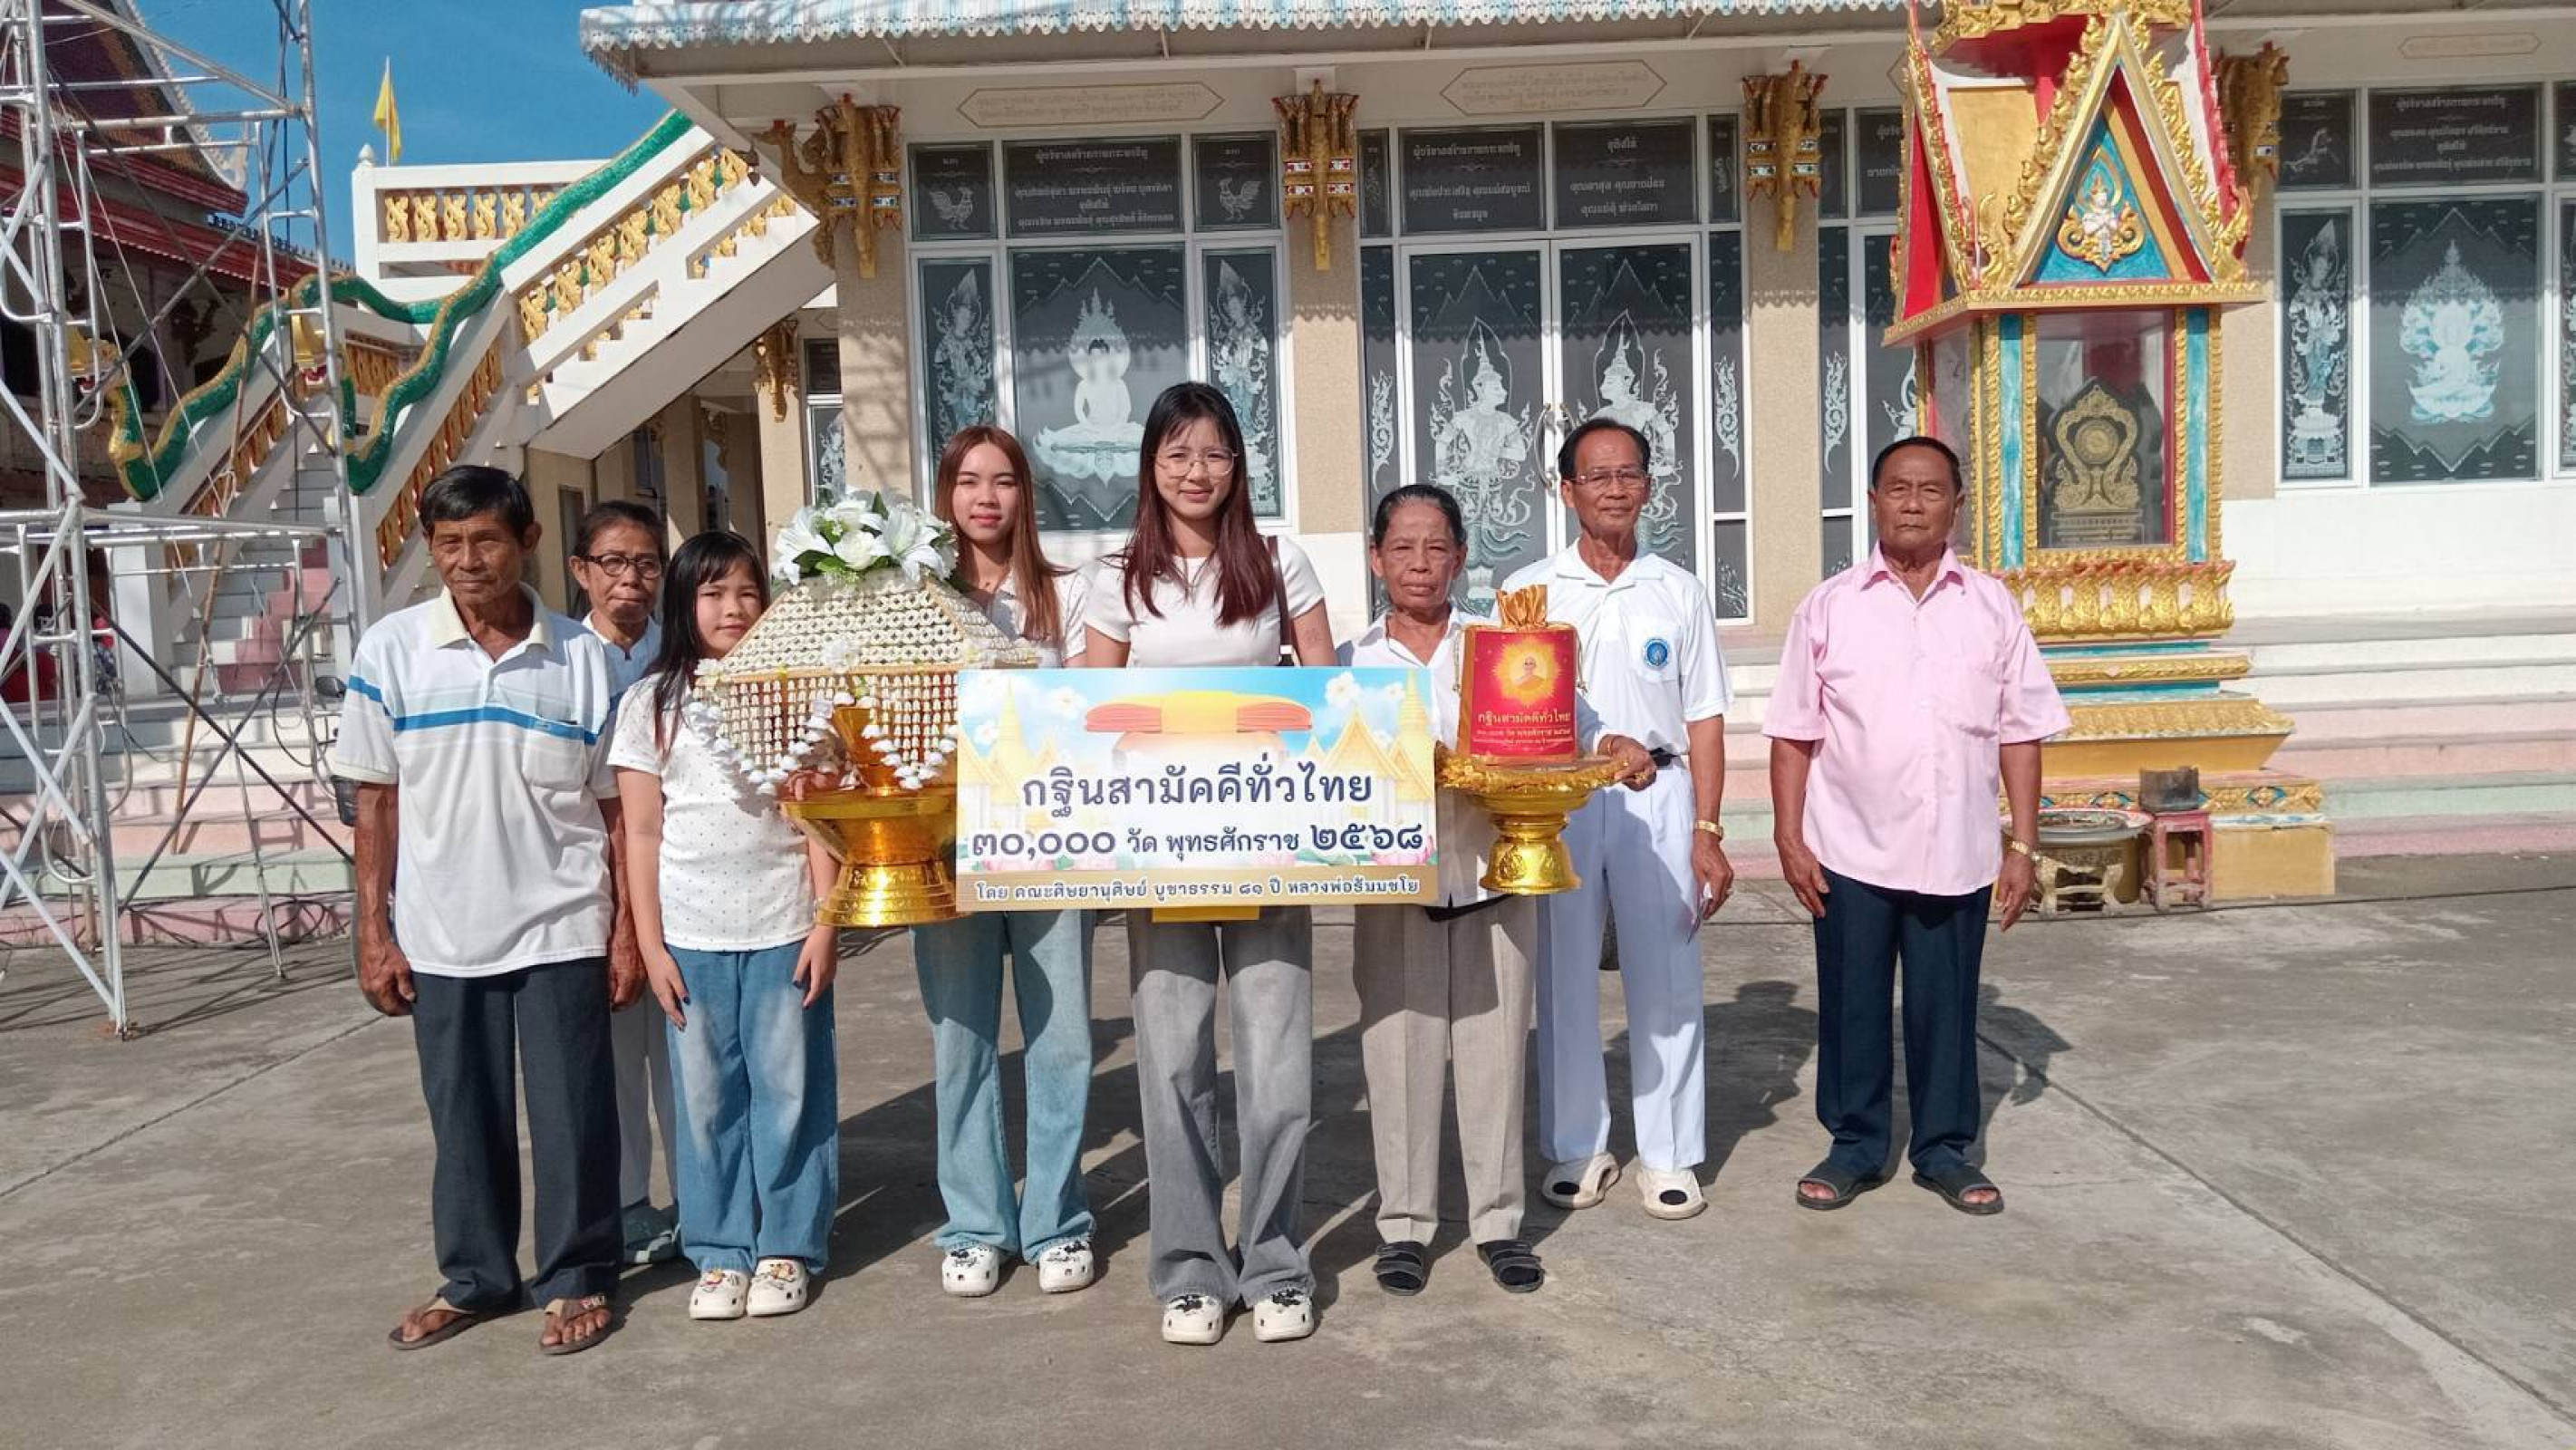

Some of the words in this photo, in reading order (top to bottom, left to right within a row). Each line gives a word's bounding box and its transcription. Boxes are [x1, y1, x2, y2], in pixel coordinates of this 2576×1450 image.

[1023, 753, 1373, 817] กฐินสามัคคีทั่วไทย
[972, 826, 1116, 860] ๓๐,๐๐๐
[1127, 826, 1158, 855] วัด
[1168, 826, 1299, 862] พุทธศักราช
[1310, 821, 1423, 852] ๒๕๖๘
[977, 881, 1008, 900] โดย
[1015, 878, 1148, 902] คณะศิษยานุศิษย์
[1154, 883, 1232, 902] บูชาธรรม
[1269, 877, 1281, 894] ปี
